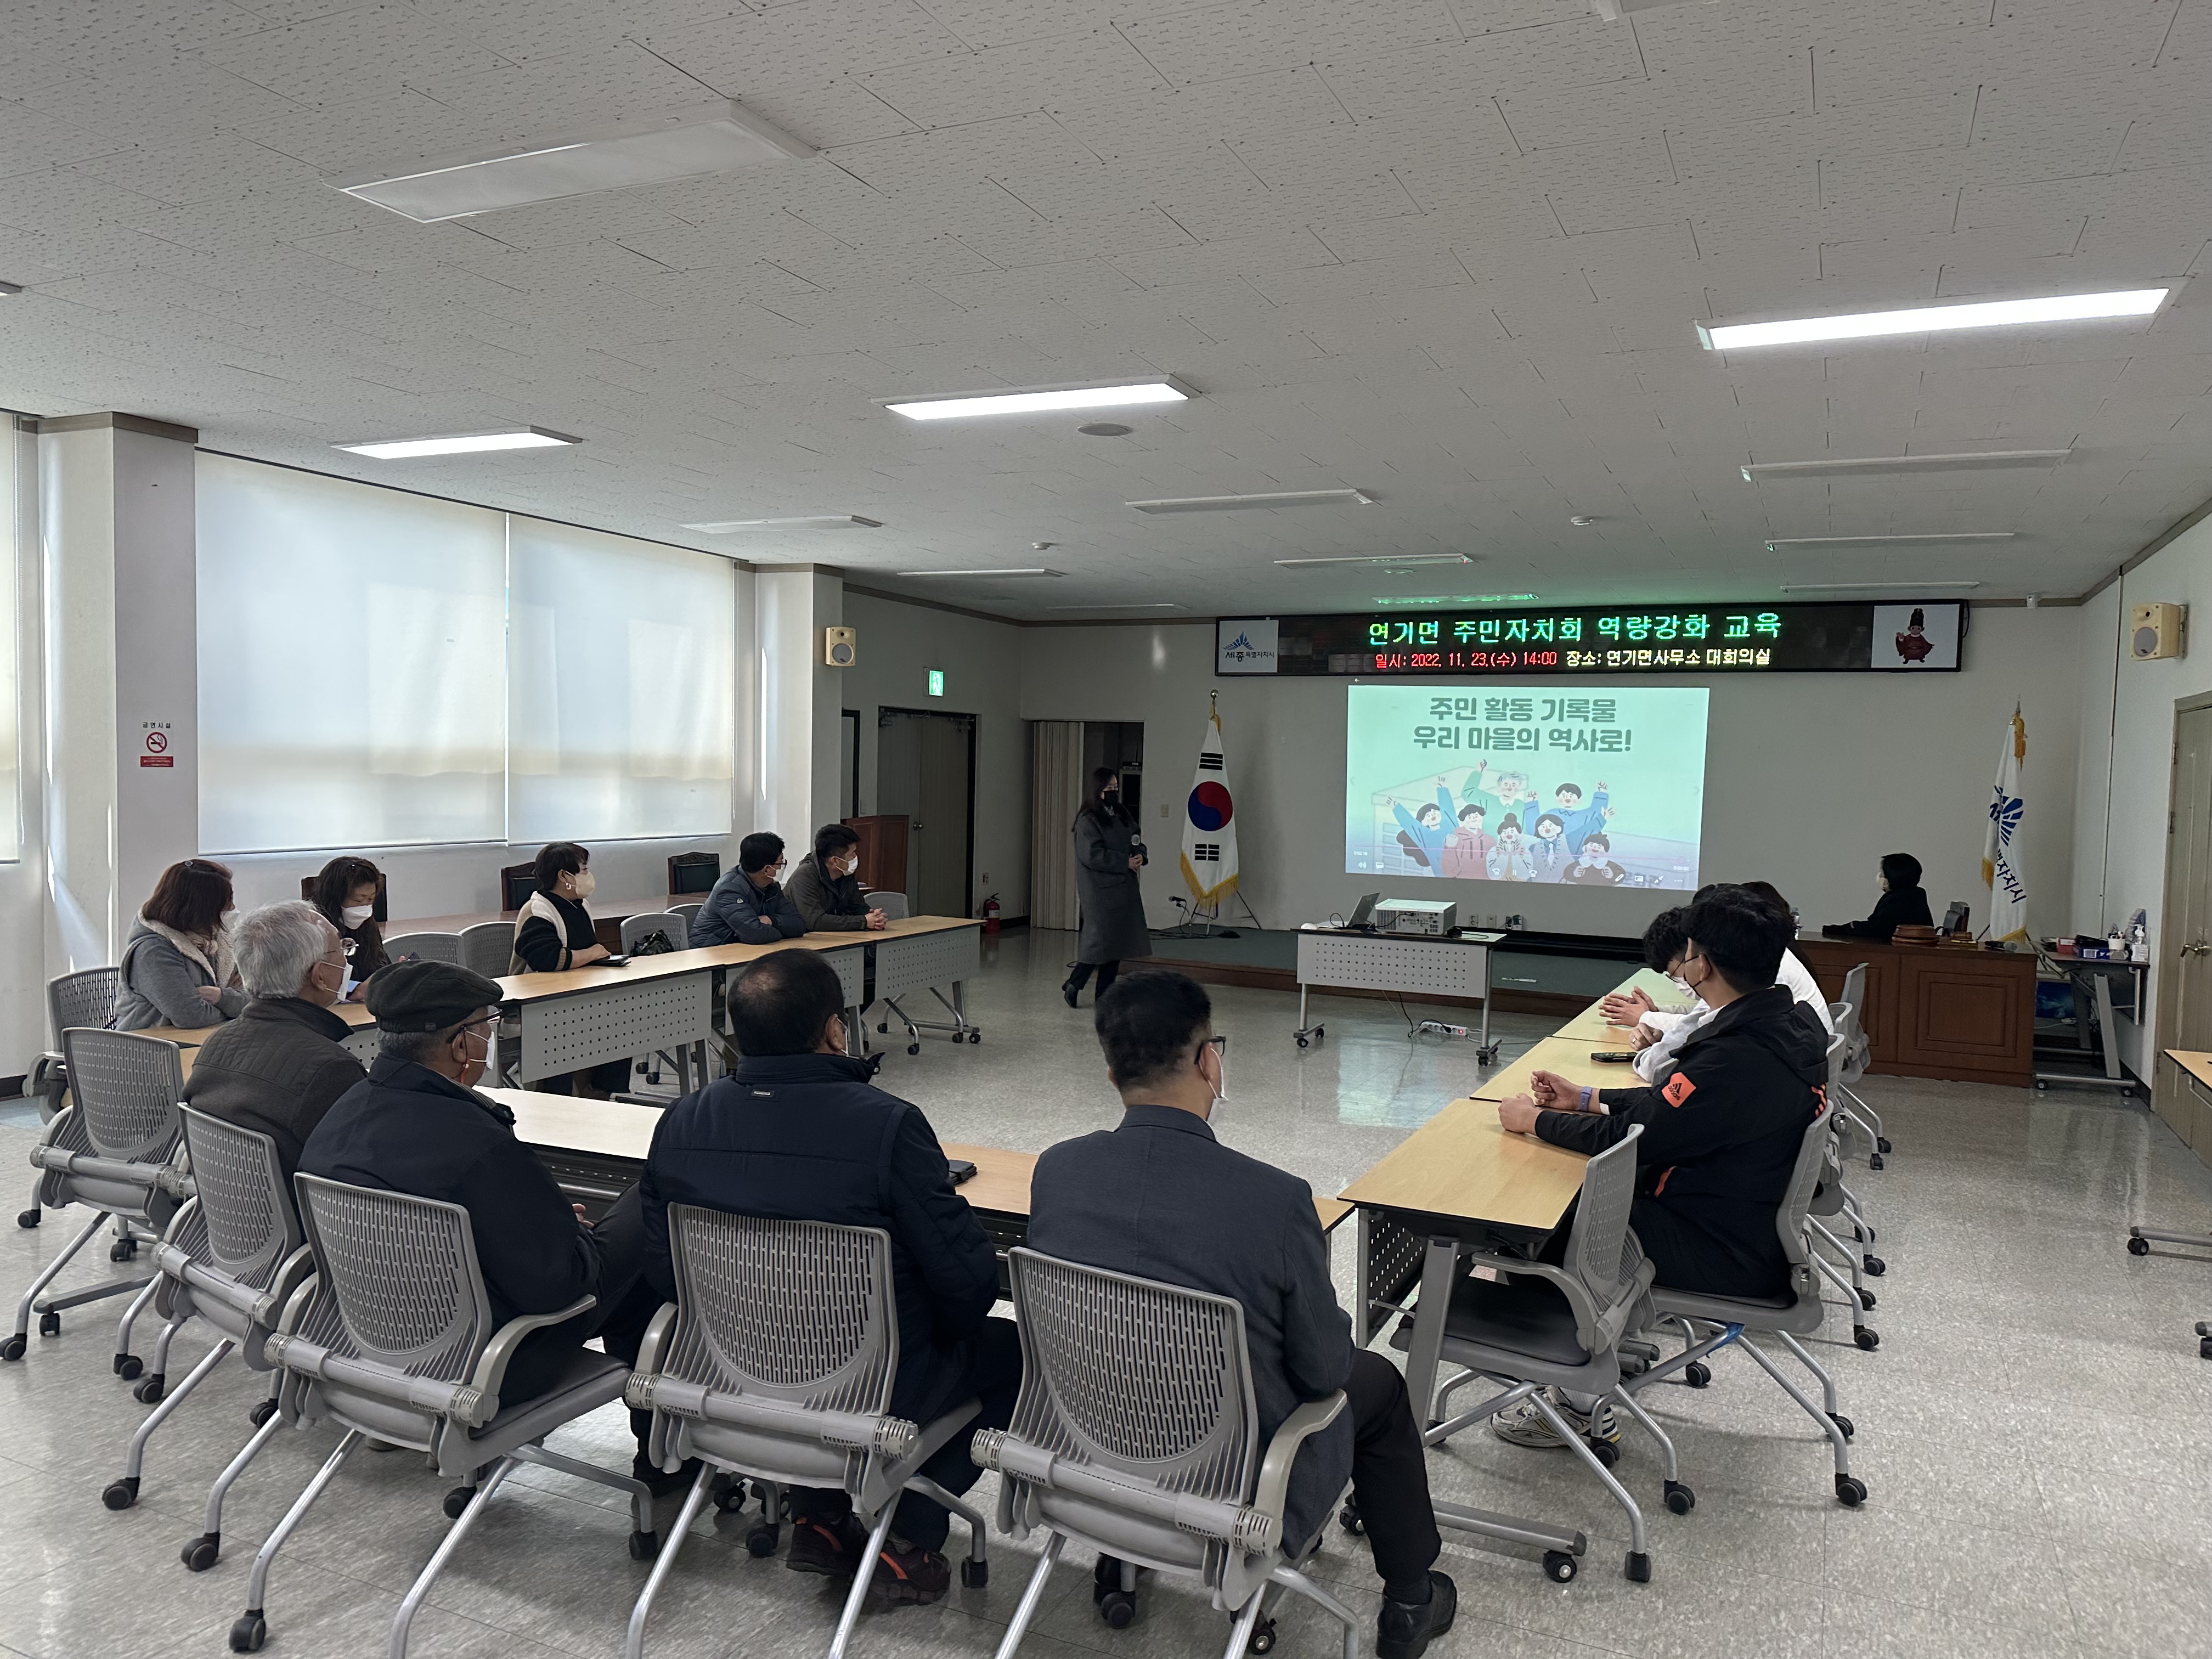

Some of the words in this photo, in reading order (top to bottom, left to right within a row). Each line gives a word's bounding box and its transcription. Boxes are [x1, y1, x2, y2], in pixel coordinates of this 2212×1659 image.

[1369, 620, 1439, 645] 연기면
[1453, 617, 1582, 643] 주민자치회
[1598, 614, 1711, 640] 역량강화
[1724, 612, 1781, 638] 교육
[1226, 651, 1244, 662] 세종
[1375, 653, 1407, 669] 일시:
[1411, 653, 1442, 668] 2022.
[1449, 652, 1465, 667] 11.
[1523, 651, 1557, 666] 14:00
[1566, 650, 1601, 667] 장소:
[1607, 648, 1701, 667] 연기면사무소
[1706, 648, 1771, 665] 대회의실
[1430, 697, 1477, 720] 주민
[1485, 697, 1533, 721] 활동
[1541, 698, 1616, 723] 기록물
[1413, 726, 1460, 749] 우리
[1468, 727, 1540, 751] 마을의
[1548, 728, 1632, 752] 역사로!
